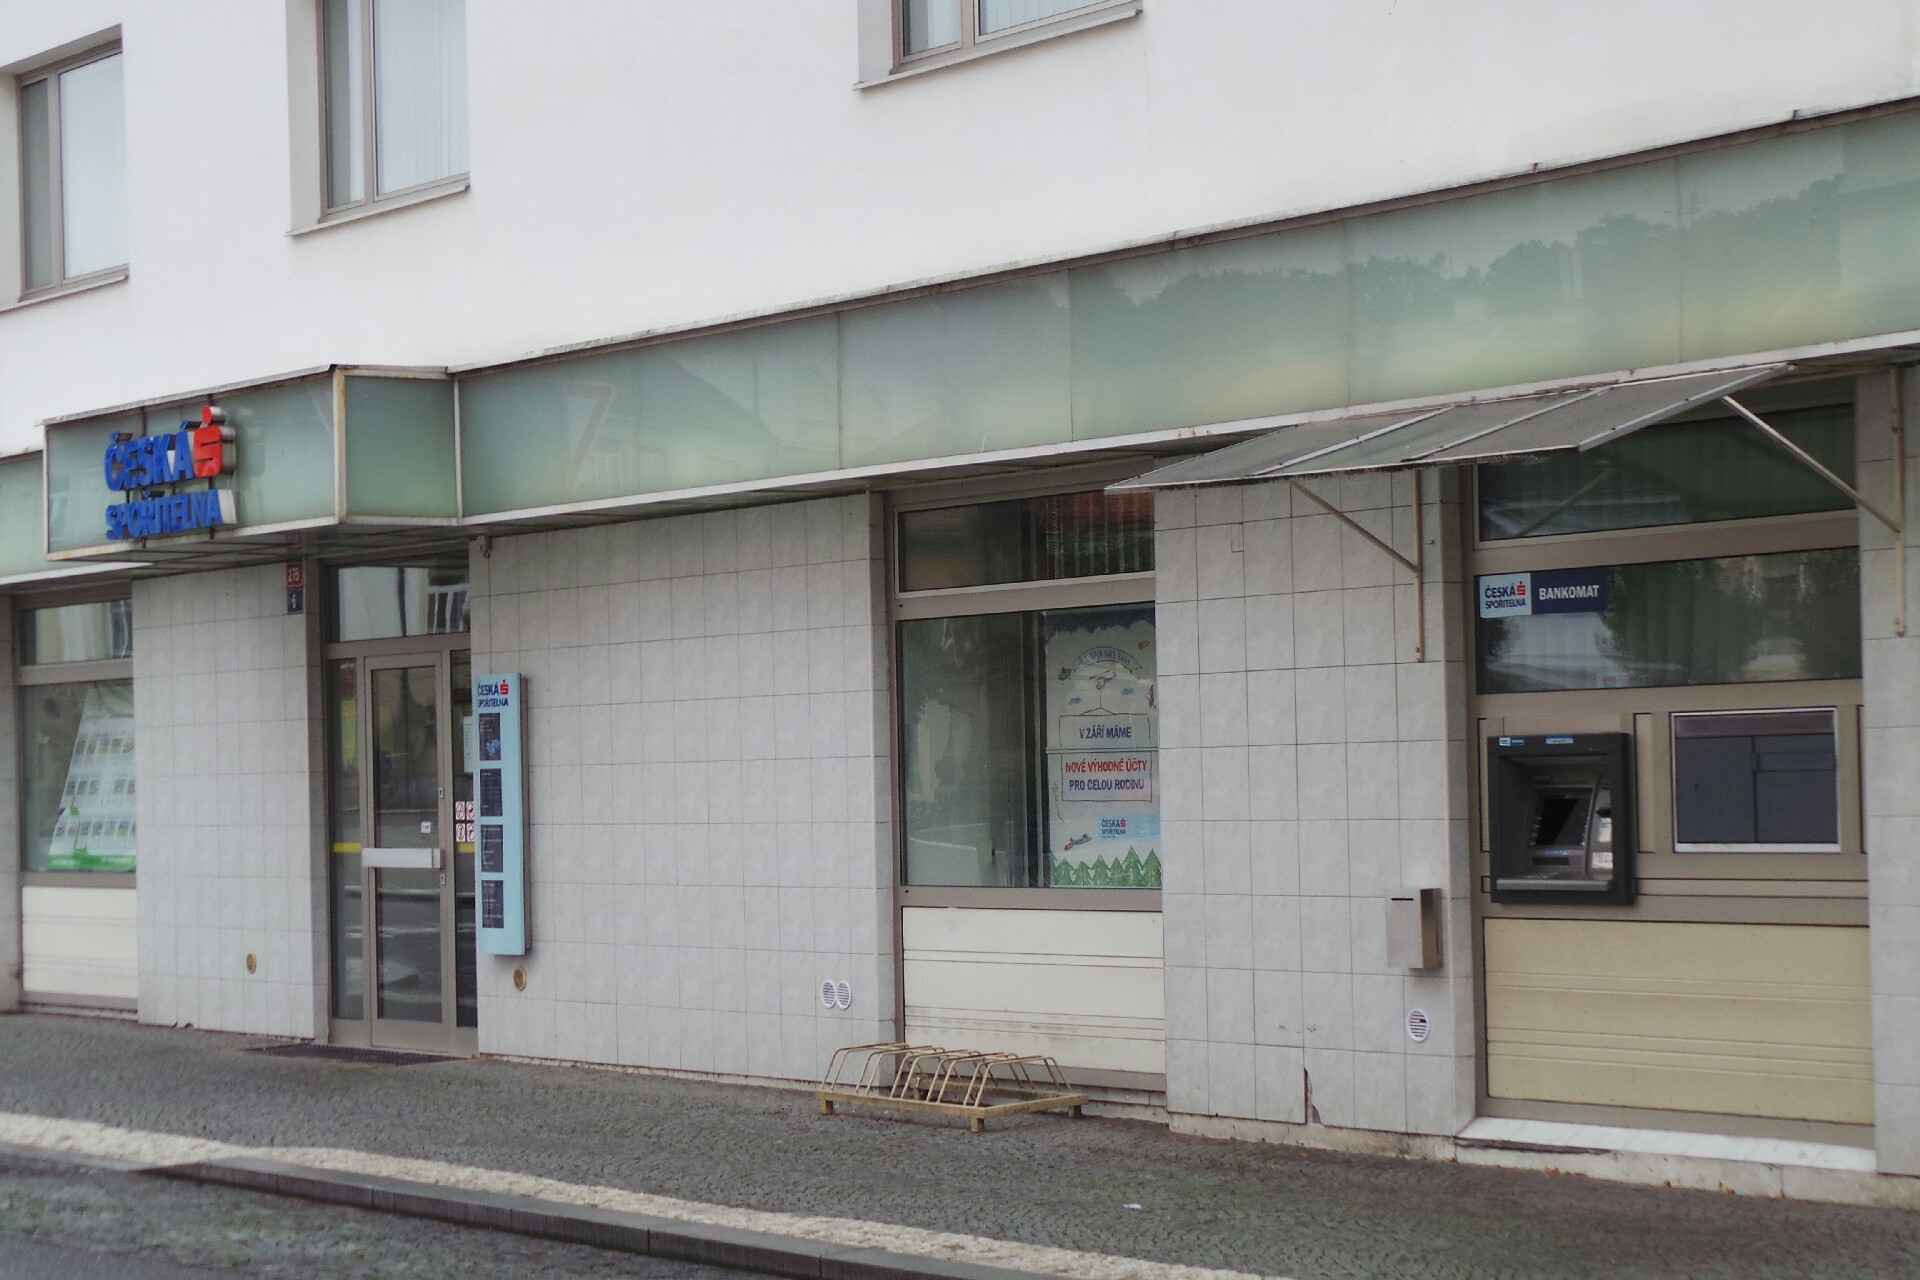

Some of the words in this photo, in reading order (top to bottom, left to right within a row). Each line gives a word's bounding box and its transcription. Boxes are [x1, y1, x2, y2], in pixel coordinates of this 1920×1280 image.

[105, 420, 194, 491] ČESKÁ
[105, 488, 222, 540] SPOŘITELNA
[1485, 582, 1516, 599] ČESKÁ
[1539, 584, 1600, 600] BANKOMAT
[1485, 598, 1526, 610] SPOŘITELNA
[478, 681, 500, 696] ČESKÁ
[1079, 728, 1085, 739] V
[1086, 725, 1104, 739] ZÁŘÍ
[1106, 725, 1131, 739] MÁME
[1065, 759, 1086, 773] NOVÉ
[1088, 758, 1124, 773] VÝHODNÉ
[1126, 758, 1147, 773] ÚČTY
[1069, 780, 1085, 791] PRO
[1087, 780, 1113, 791] CELOU
[1115, 779, 1145, 791] RODINU
